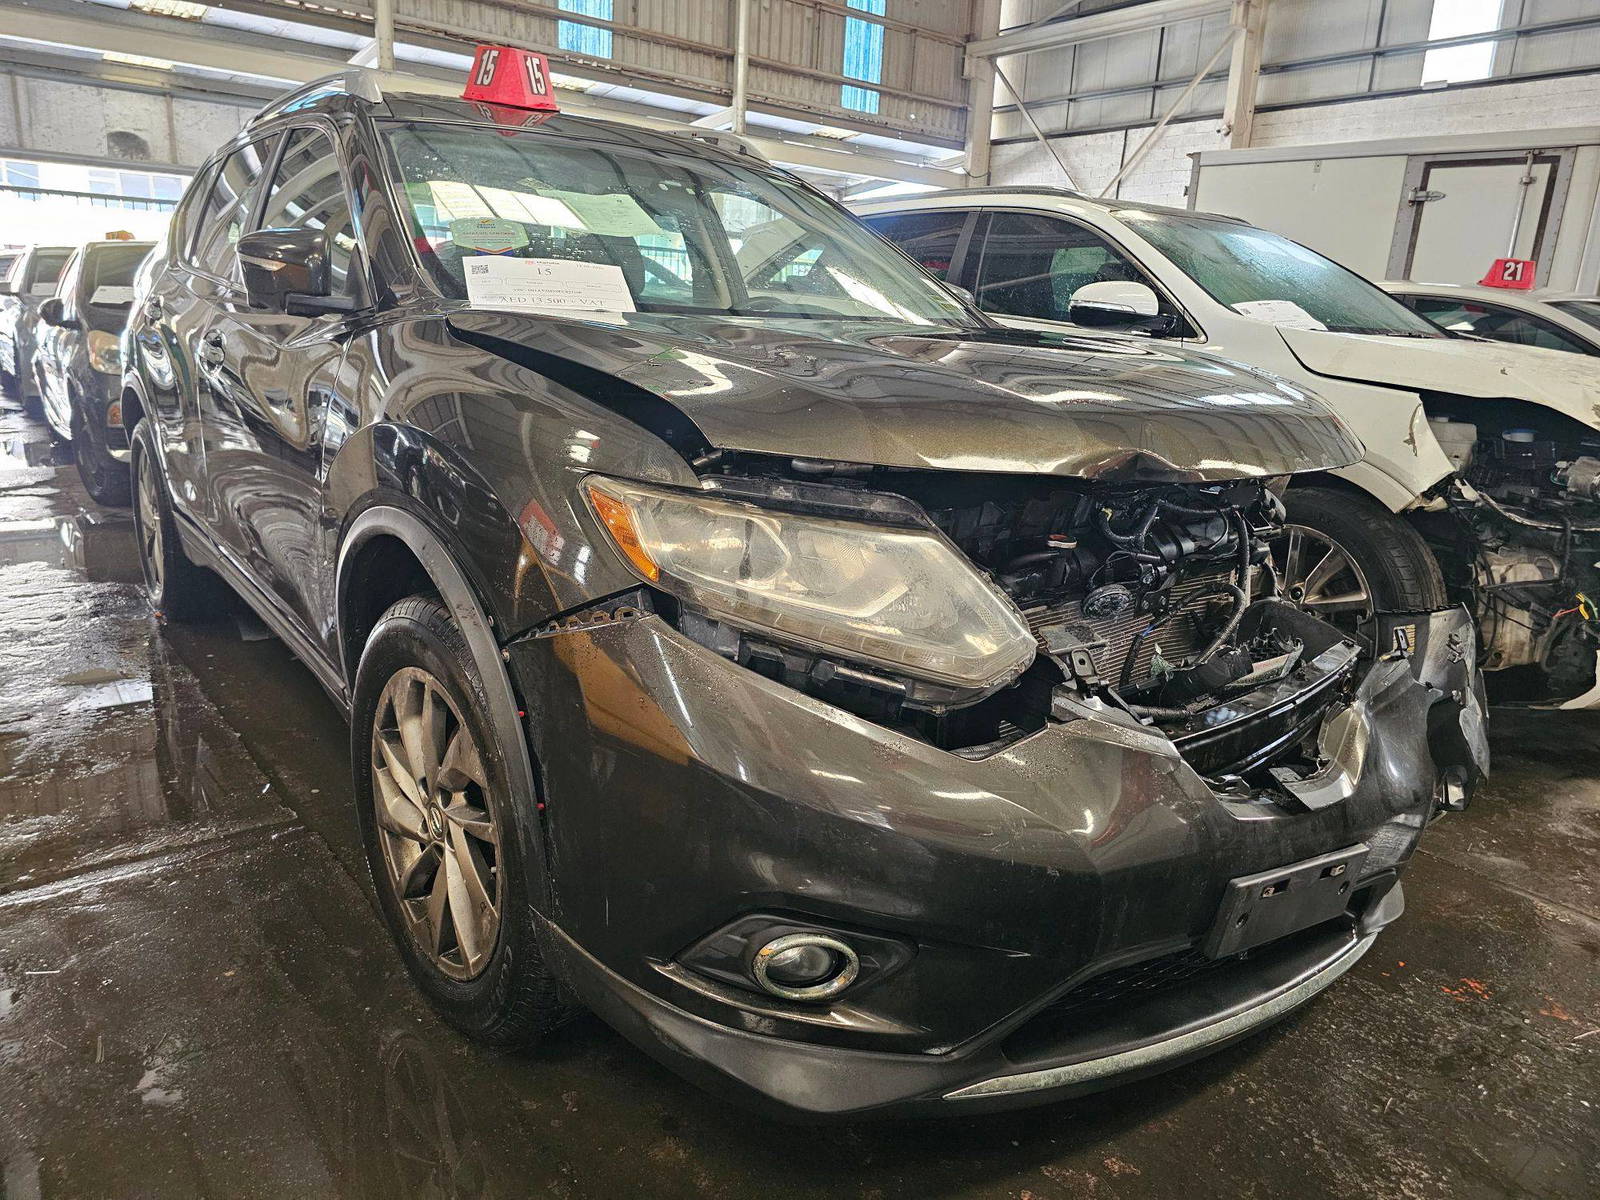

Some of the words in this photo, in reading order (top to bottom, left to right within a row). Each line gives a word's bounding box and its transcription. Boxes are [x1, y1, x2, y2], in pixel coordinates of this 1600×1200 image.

[476, 50, 499, 86] 15
[526, 56, 546, 95] 15
[537, 267, 552, 276] 15
[1503, 261, 1524, 281] 21
